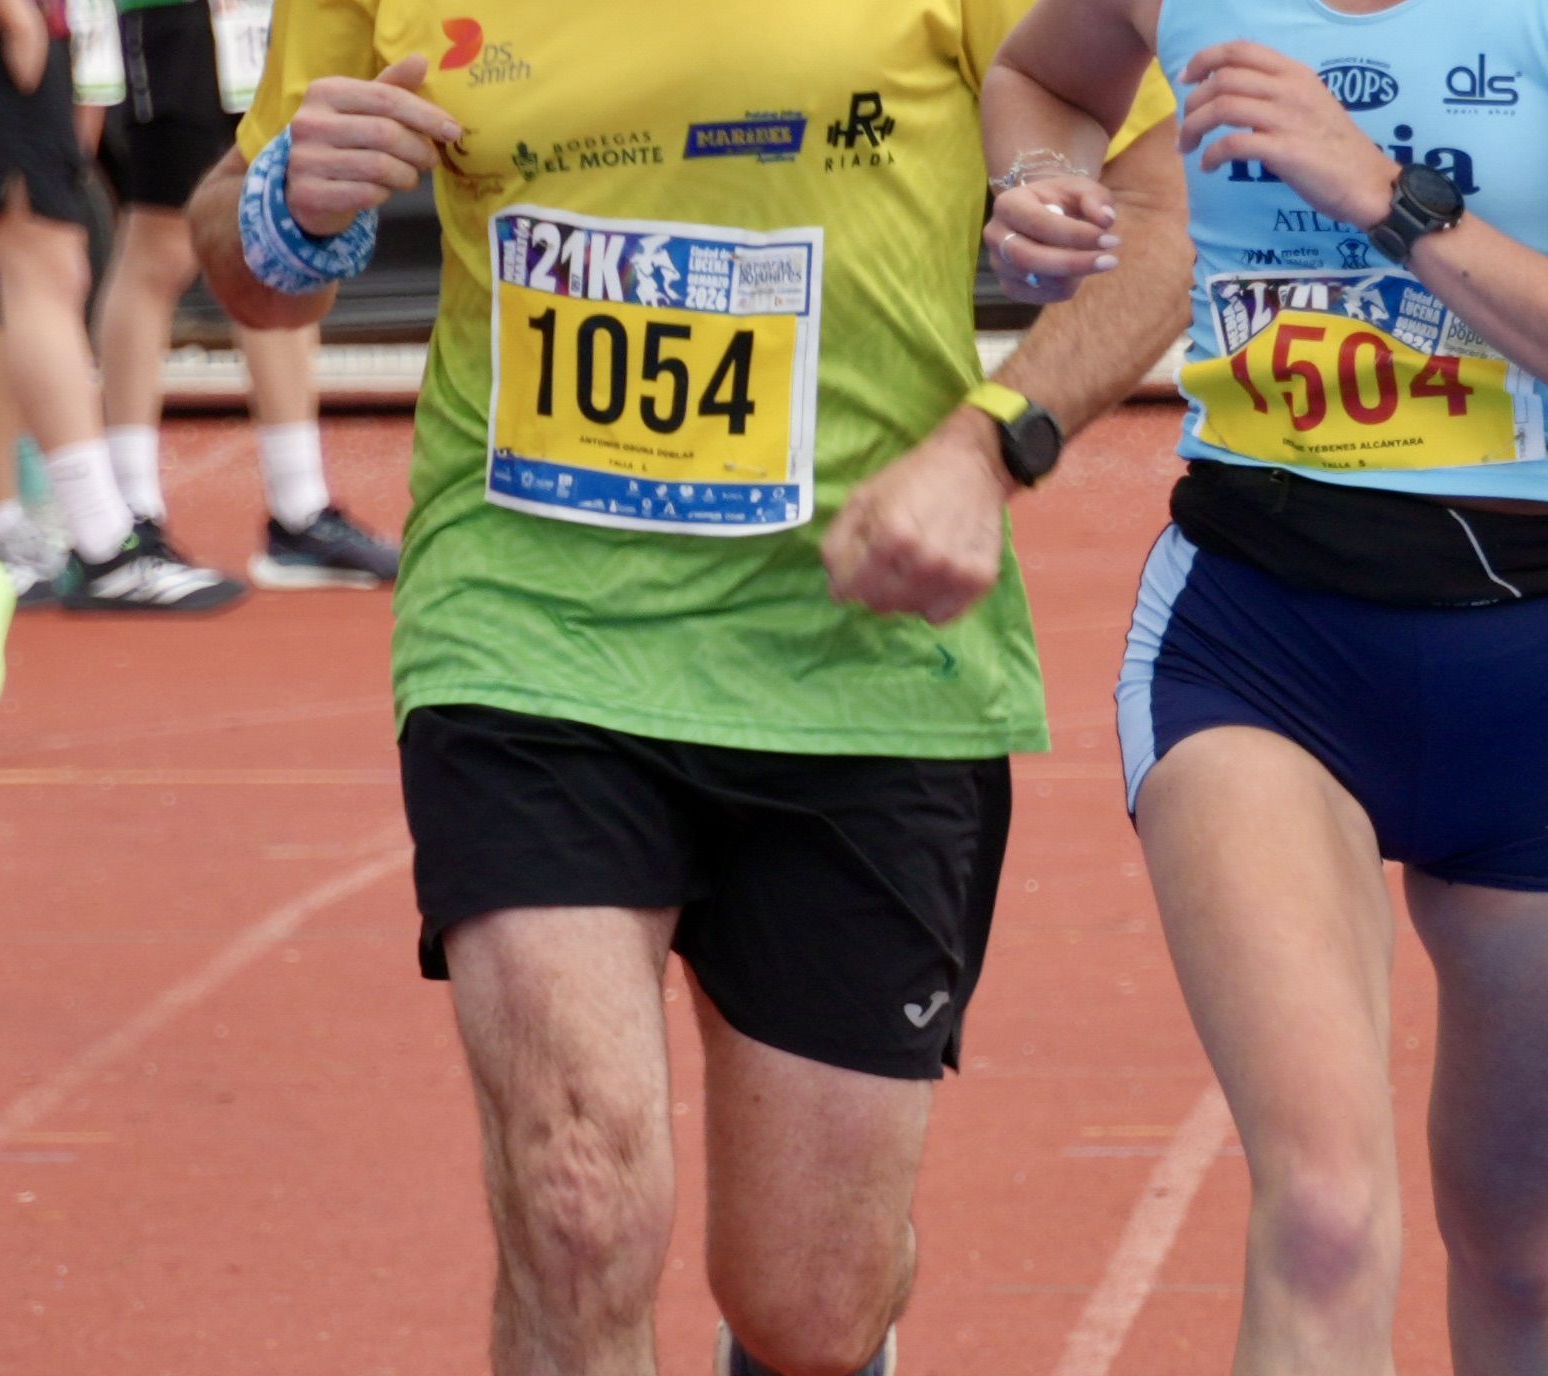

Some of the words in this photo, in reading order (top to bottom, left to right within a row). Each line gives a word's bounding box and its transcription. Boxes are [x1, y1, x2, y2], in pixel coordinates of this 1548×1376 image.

[483, 42, 514, 64] DS
[468, 60, 532, 87] Smith
[1443, 53, 1519, 106] als
[552, 131, 652, 154] BODEGAS
[545, 154, 570, 173] EL
[580, 146, 664, 170] MONTE
[529, 222, 625, 302] 21K
[685, 287, 728, 312] 2026
[1399, 298, 1442, 323] LUCENA
[1447, 326, 1490, 345] popu
[529, 306, 756, 436] 1054
[1230, 323, 1474, 432] 1504
